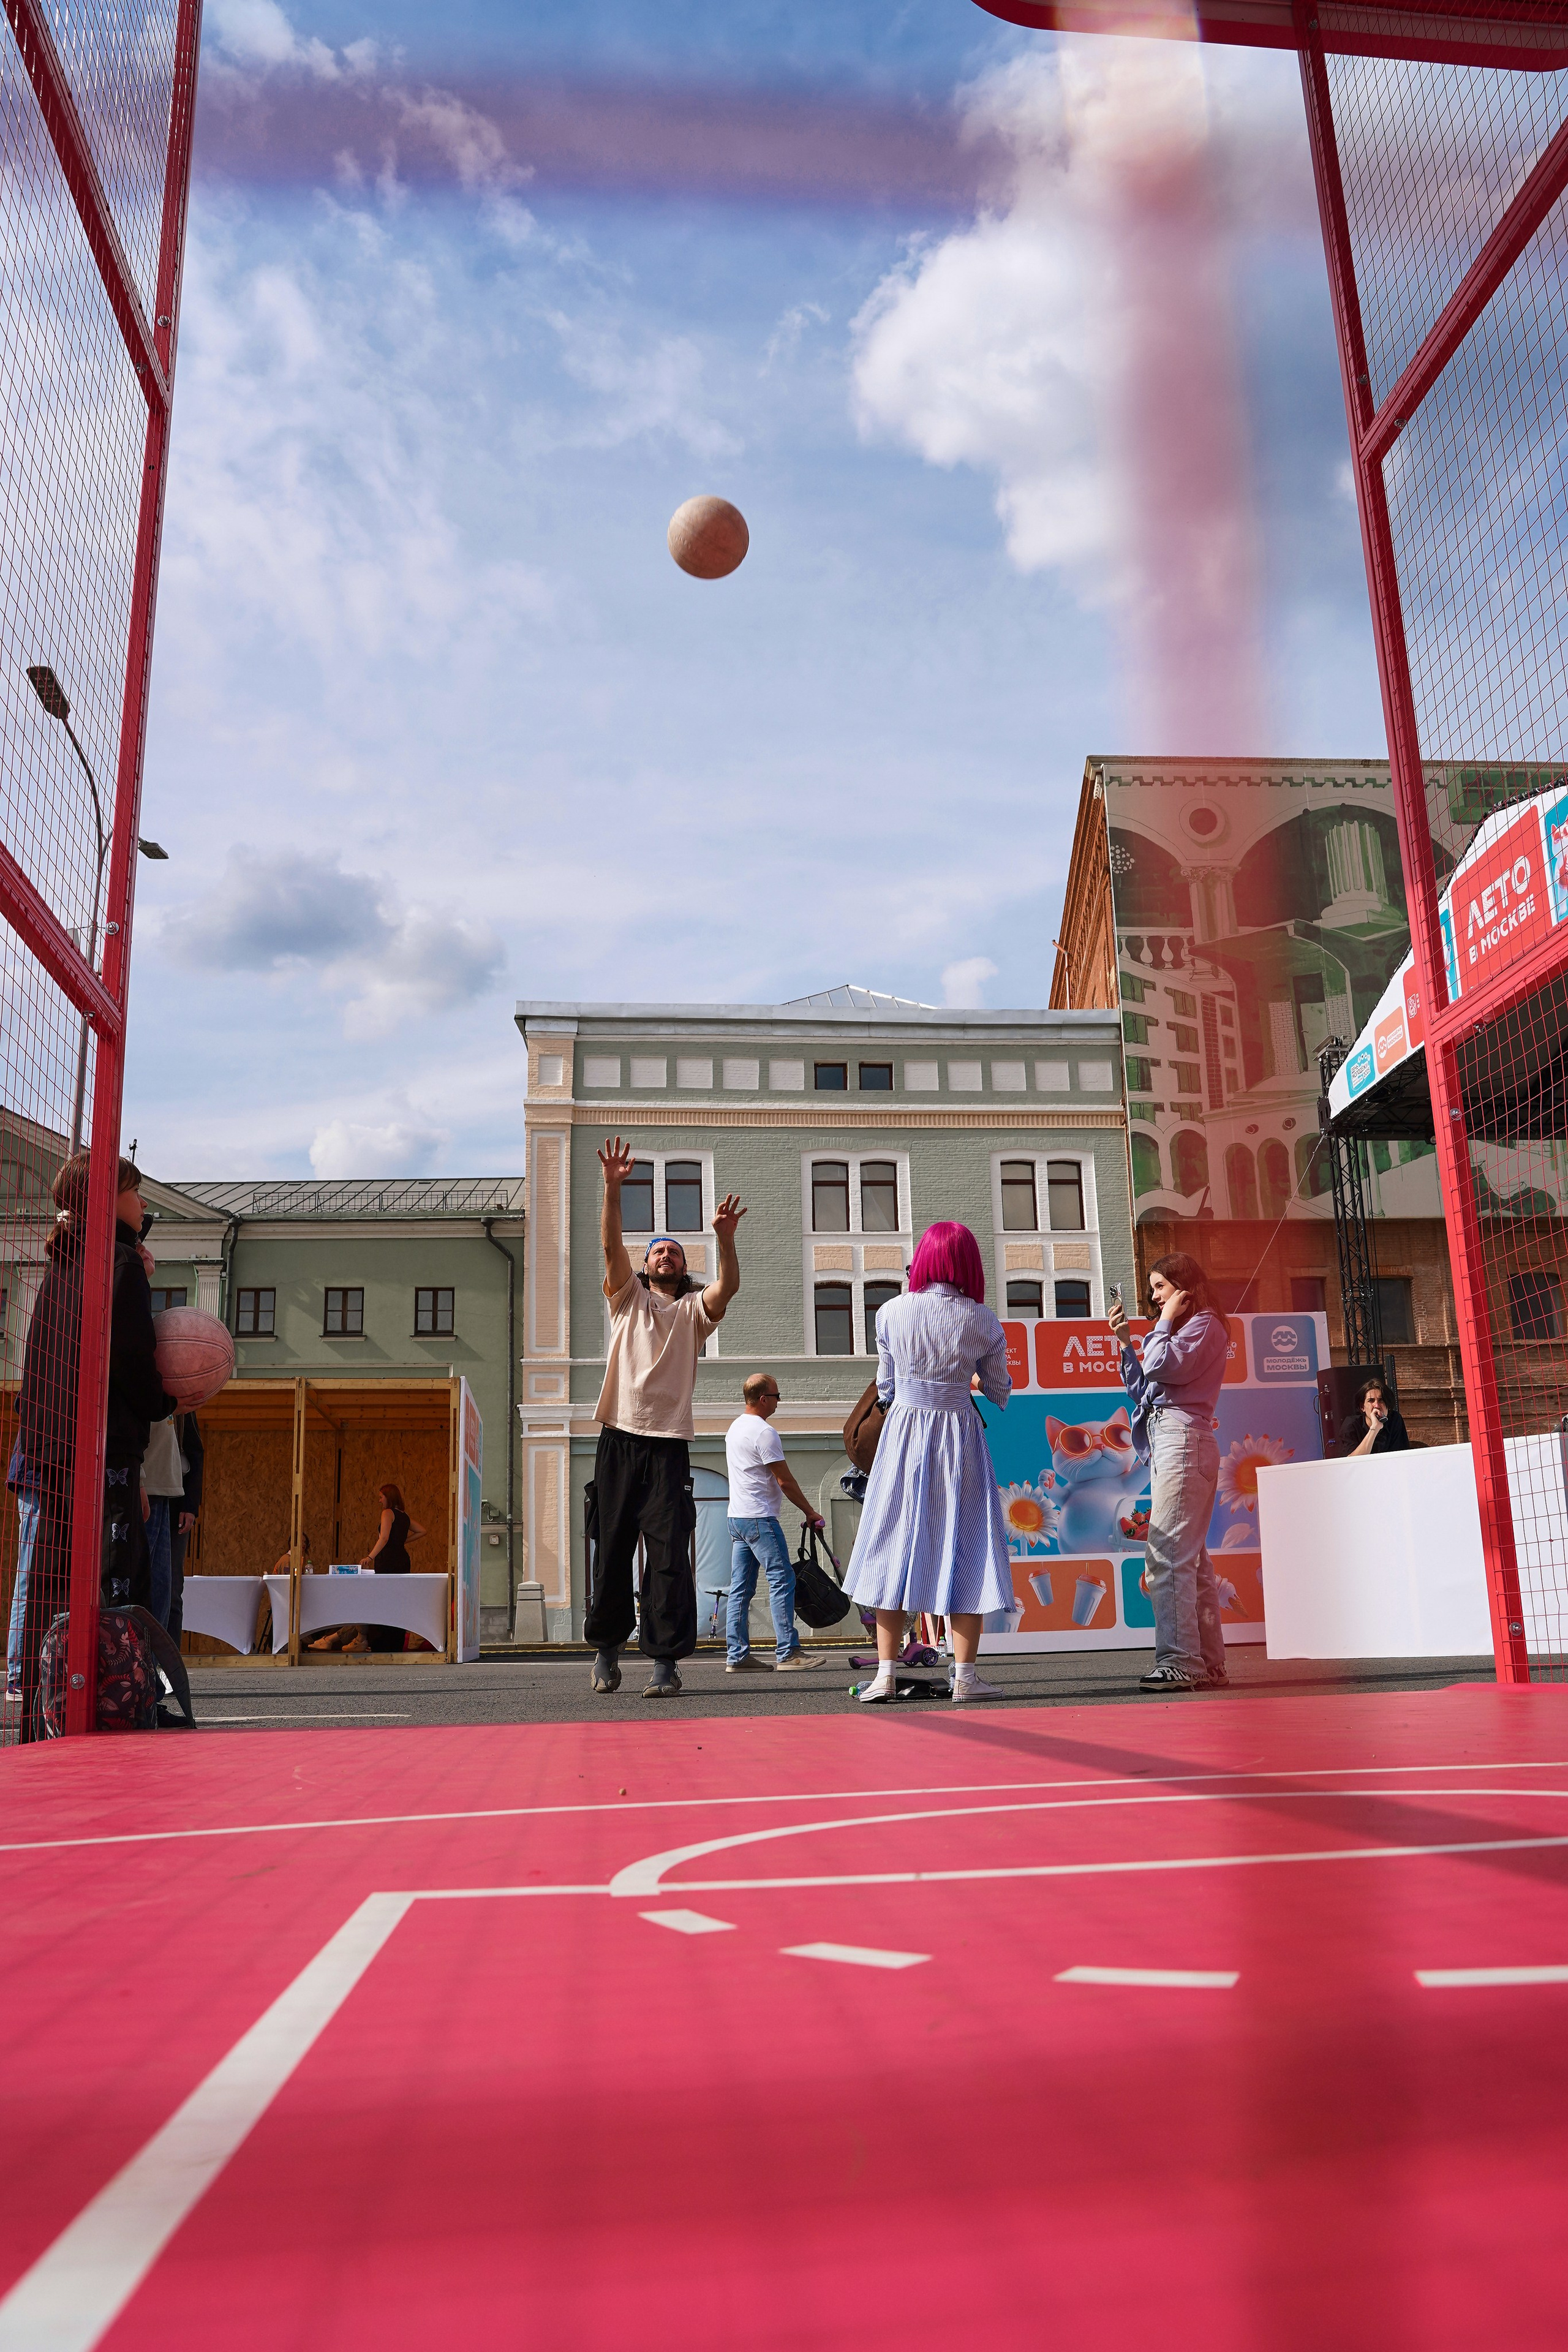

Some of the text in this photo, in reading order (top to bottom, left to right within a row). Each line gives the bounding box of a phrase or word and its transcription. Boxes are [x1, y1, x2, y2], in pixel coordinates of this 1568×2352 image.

[1468, 855, 1531, 940] ЛЕТО
[1469, 893, 1536, 965] В МОСКВЕ
[1063, 1362, 1074, 1373] В
